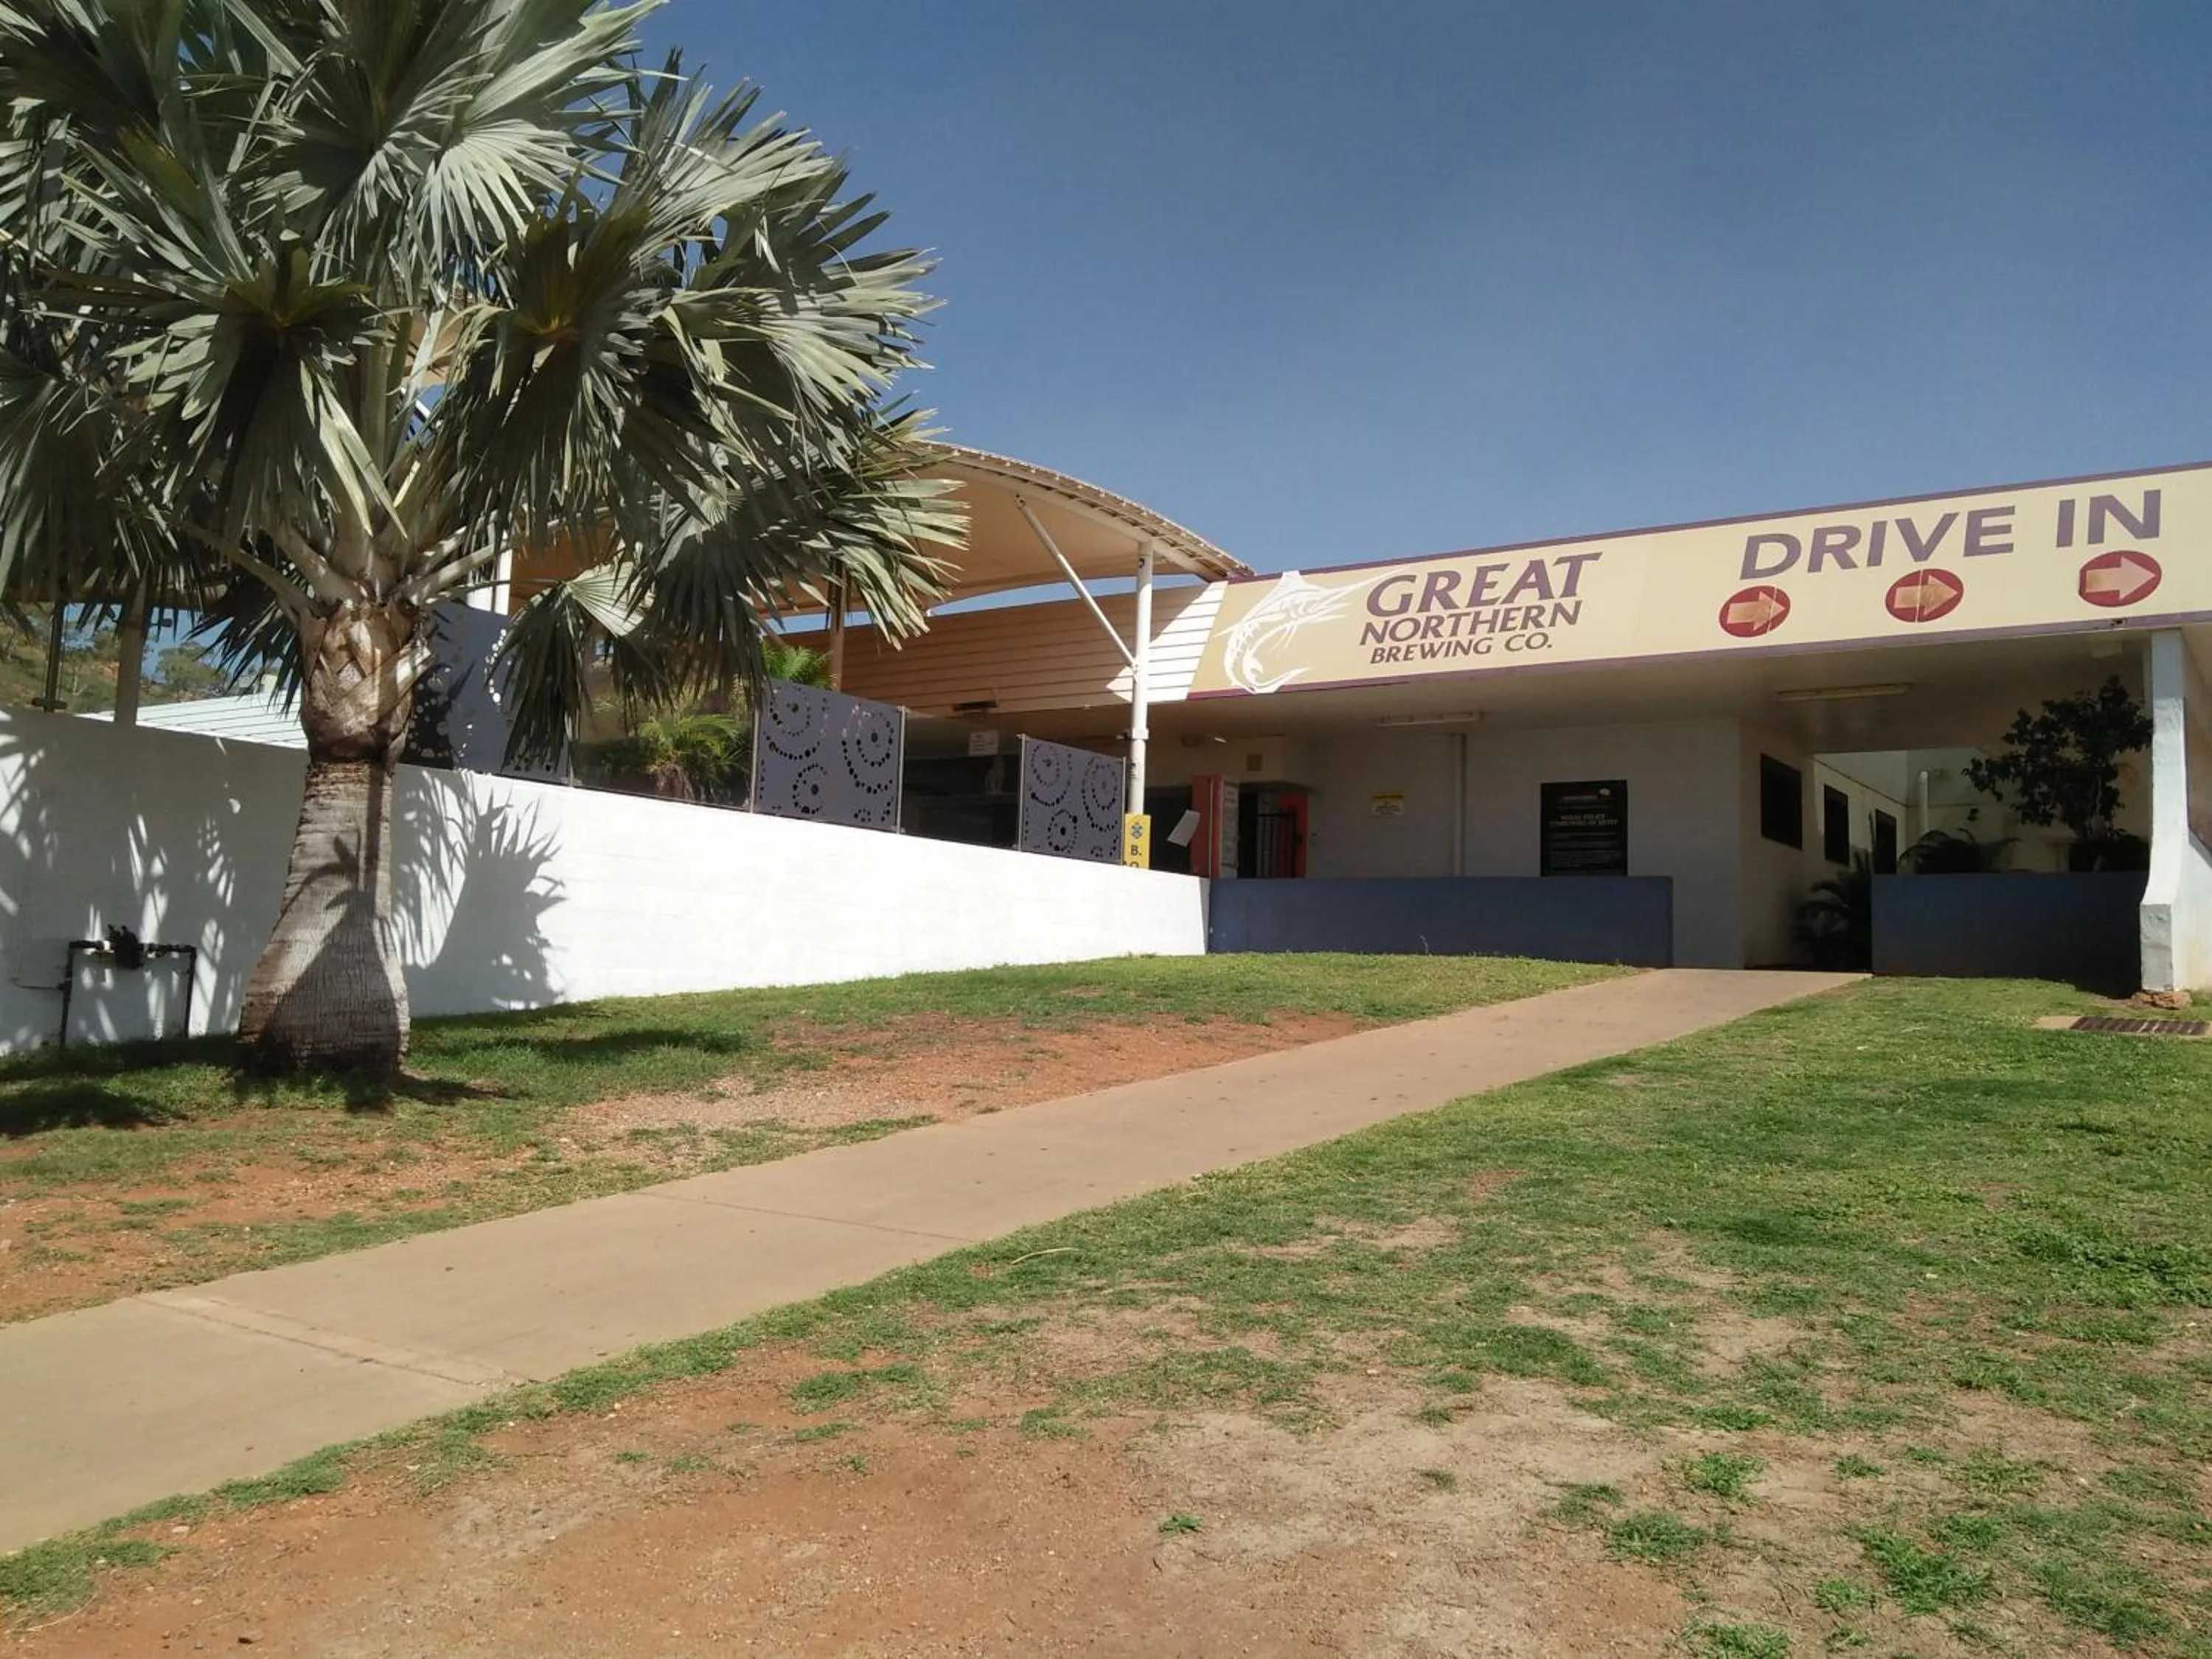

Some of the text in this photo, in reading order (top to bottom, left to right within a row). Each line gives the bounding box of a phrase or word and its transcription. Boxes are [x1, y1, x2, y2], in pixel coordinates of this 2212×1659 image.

[1739, 489, 2161, 580] DRIVE IN
[1366, 552, 1604, 617] GREAT
[1359, 600, 1583, 646] NORTHERN
[1369, 632, 1552, 664] BREWING CO.
